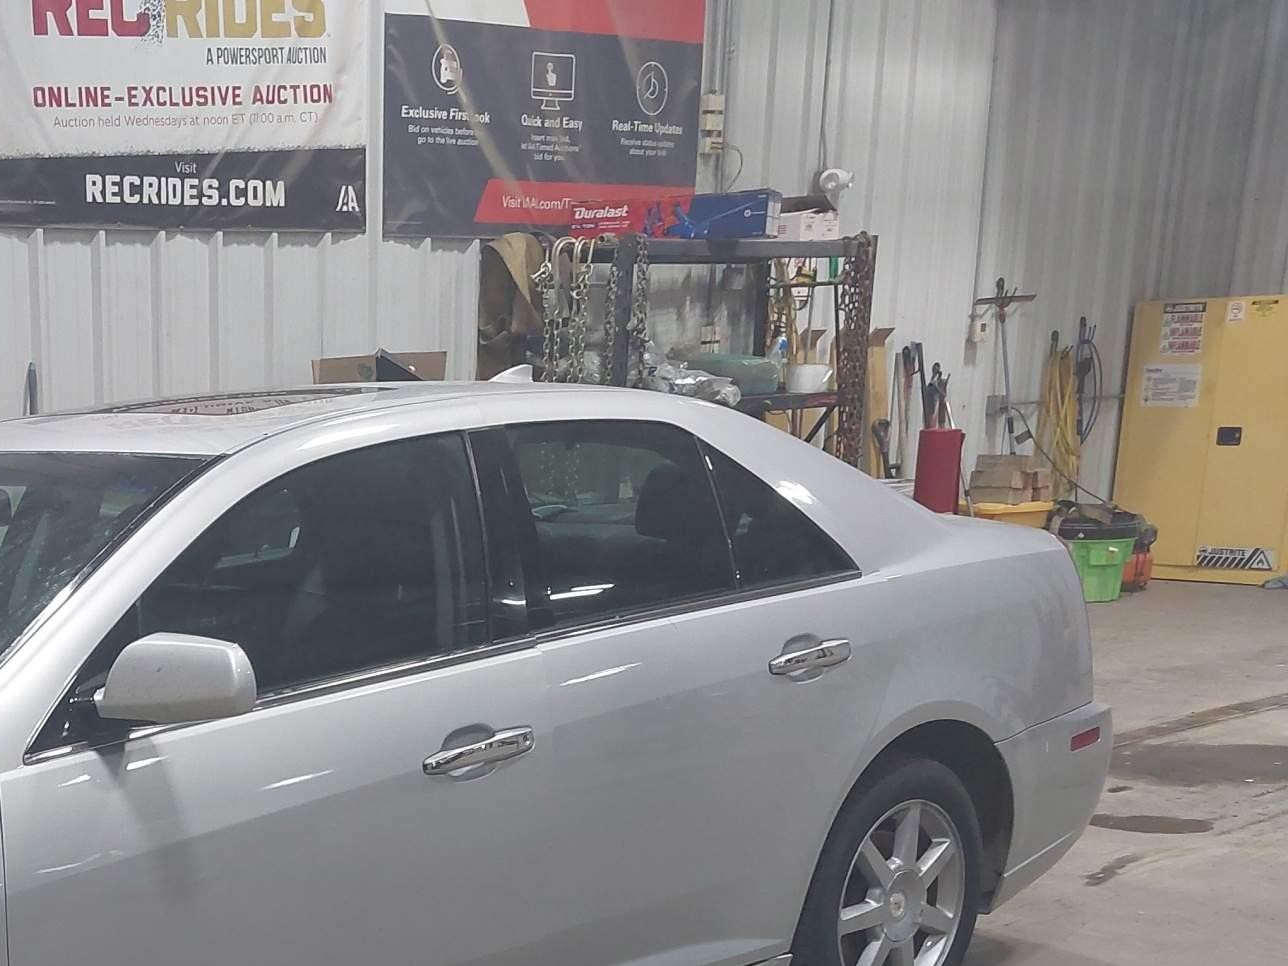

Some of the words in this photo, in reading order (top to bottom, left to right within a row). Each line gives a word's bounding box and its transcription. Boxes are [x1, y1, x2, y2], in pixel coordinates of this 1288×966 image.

[206, 47, 213, 65] A
[217, 47, 285, 65] POWERSPORT
[287, 46, 327, 65] AUCTION
[33, 85, 242, 108] ONLINE-EXCLUSIVE
[252, 83, 333, 105] AUCTION
[54, 115, 95, 128] Auction
[98, 115, 121, 127] held
[124, 114, 187, 128] Wednesdays
[190, 115, 200, 126] at
[203, 115, 229, 126] noon
[232, 113, 246, 124] ET
[401, 105, 447, 120] Exclusive
[521, 113, 542, 127] Quick
[544, 117, 560, 128] and
[563, 116, 583, 132] Easy
[612, 119, 653, 132] Real-Time
[654, 122, 683, 136] Updates
[175, 161, 197, 174] Visit
[85, 174, 286, 207] RECRIDES.COM
[502, 195, 521, 208] Visit
[573, 204, 629, 219] Duralast
